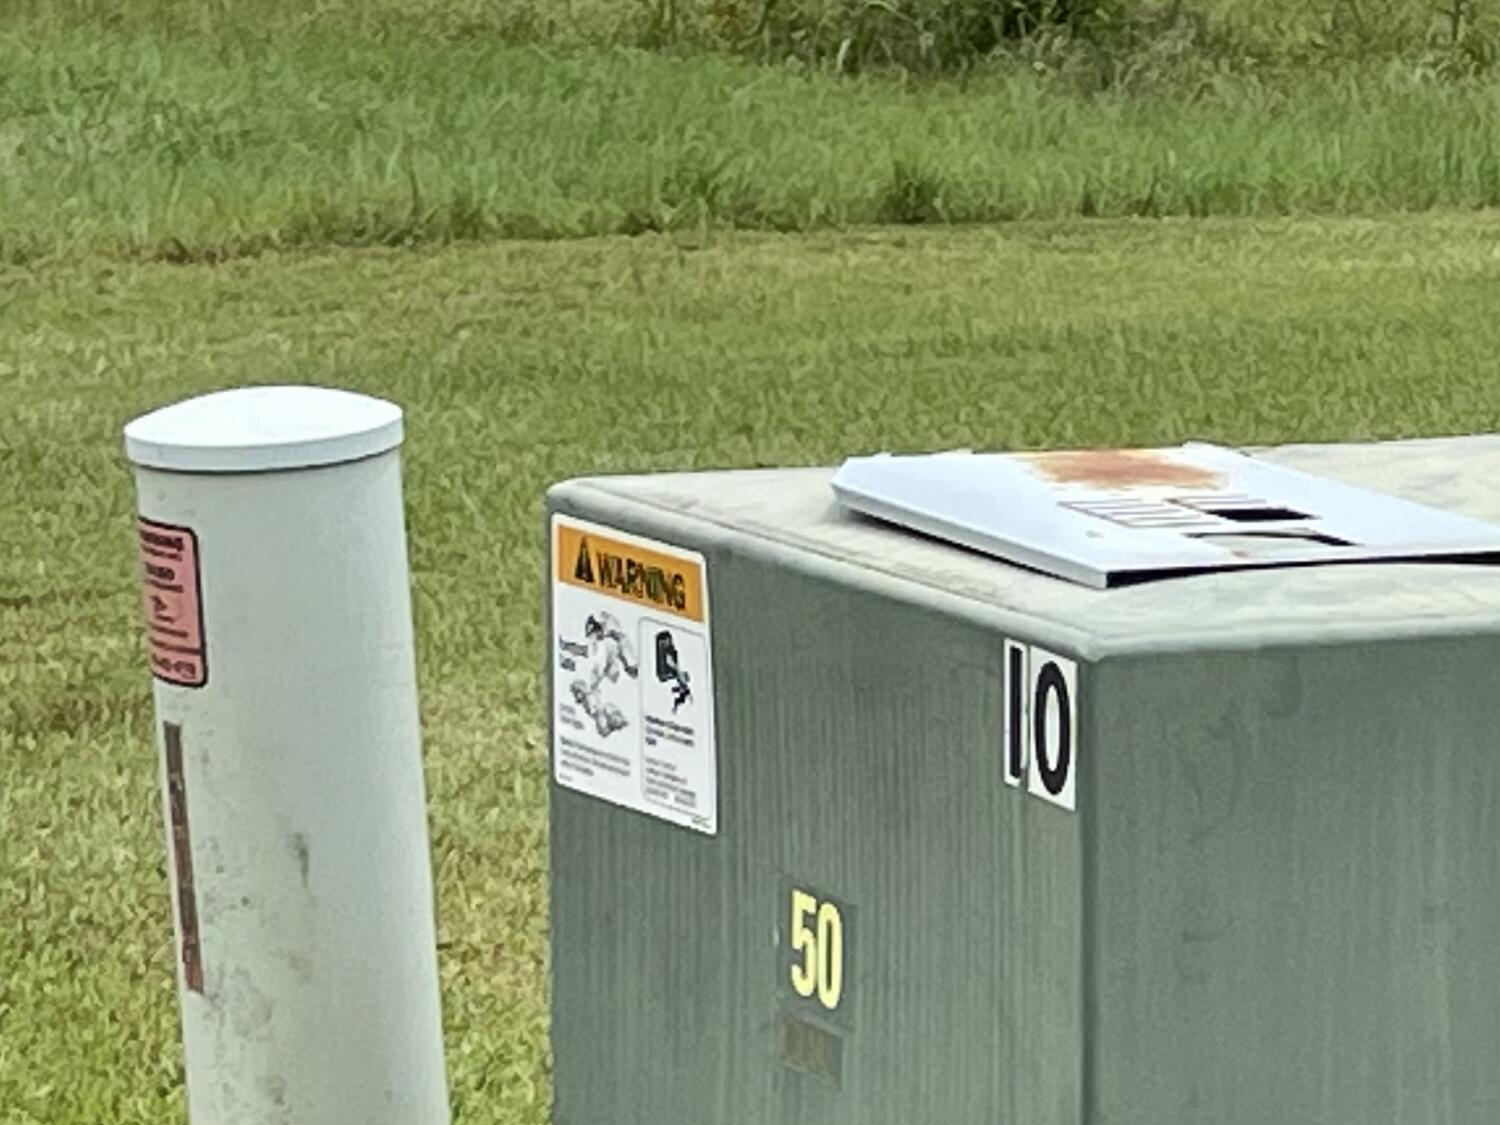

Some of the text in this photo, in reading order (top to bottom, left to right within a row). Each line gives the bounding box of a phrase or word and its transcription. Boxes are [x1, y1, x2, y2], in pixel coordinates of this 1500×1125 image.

[597, 550, 686, 611] WARNING
[1009, 645, 1071, 796] 10
[790, 889, 843, 1010] 50
